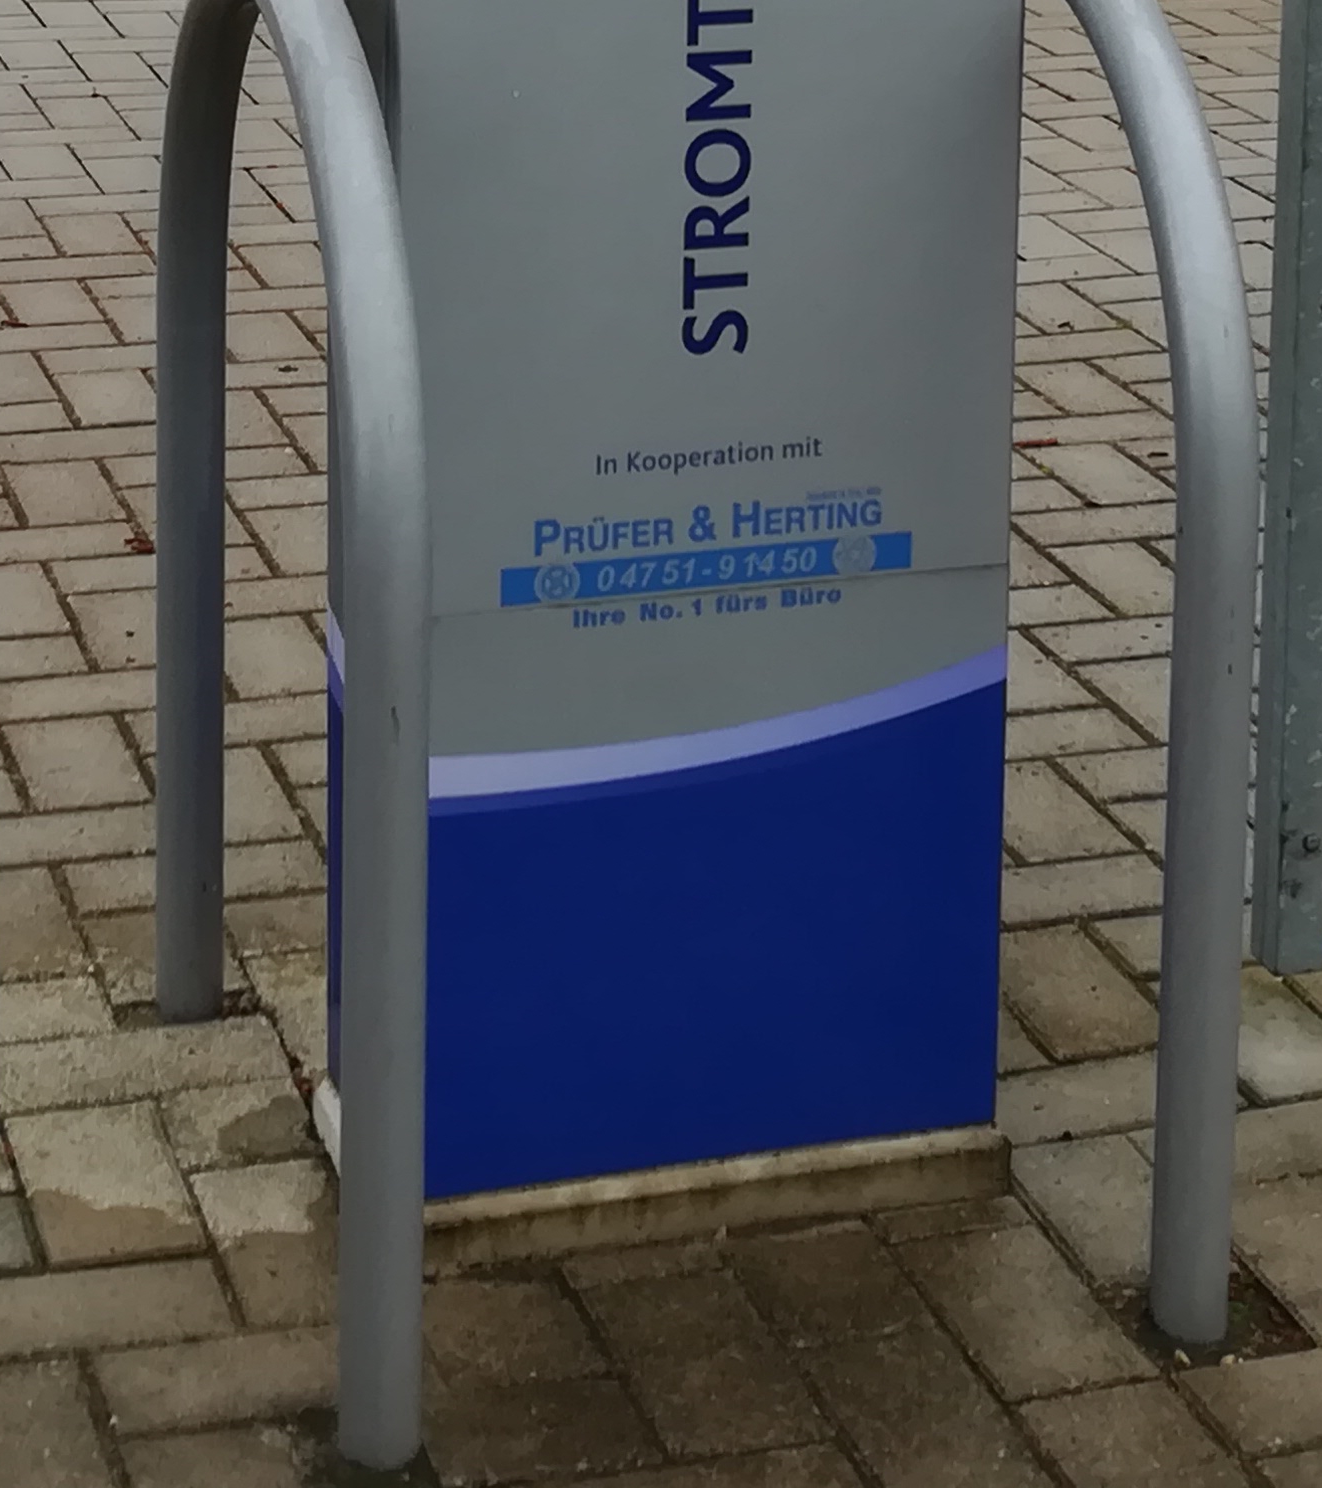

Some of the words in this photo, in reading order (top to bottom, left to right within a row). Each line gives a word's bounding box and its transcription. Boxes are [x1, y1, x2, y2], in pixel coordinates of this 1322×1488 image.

[596, 454, 617, 475] In
[627, 442, 774, 475] Kooperation
[782, 437, 823, 459] mit
[534, 517, 674, 557] PRÜFER
[688, 505, 717, 543] &
[732, 499, 883, 539] HERTING
[573, 609, 626, 629] Ihre
[640, 603, 683, 623] No.
[691, 599, 703, 617] 1
[716, 594, 768, 614] fürs
[781, 587, 841, 608] Büro
